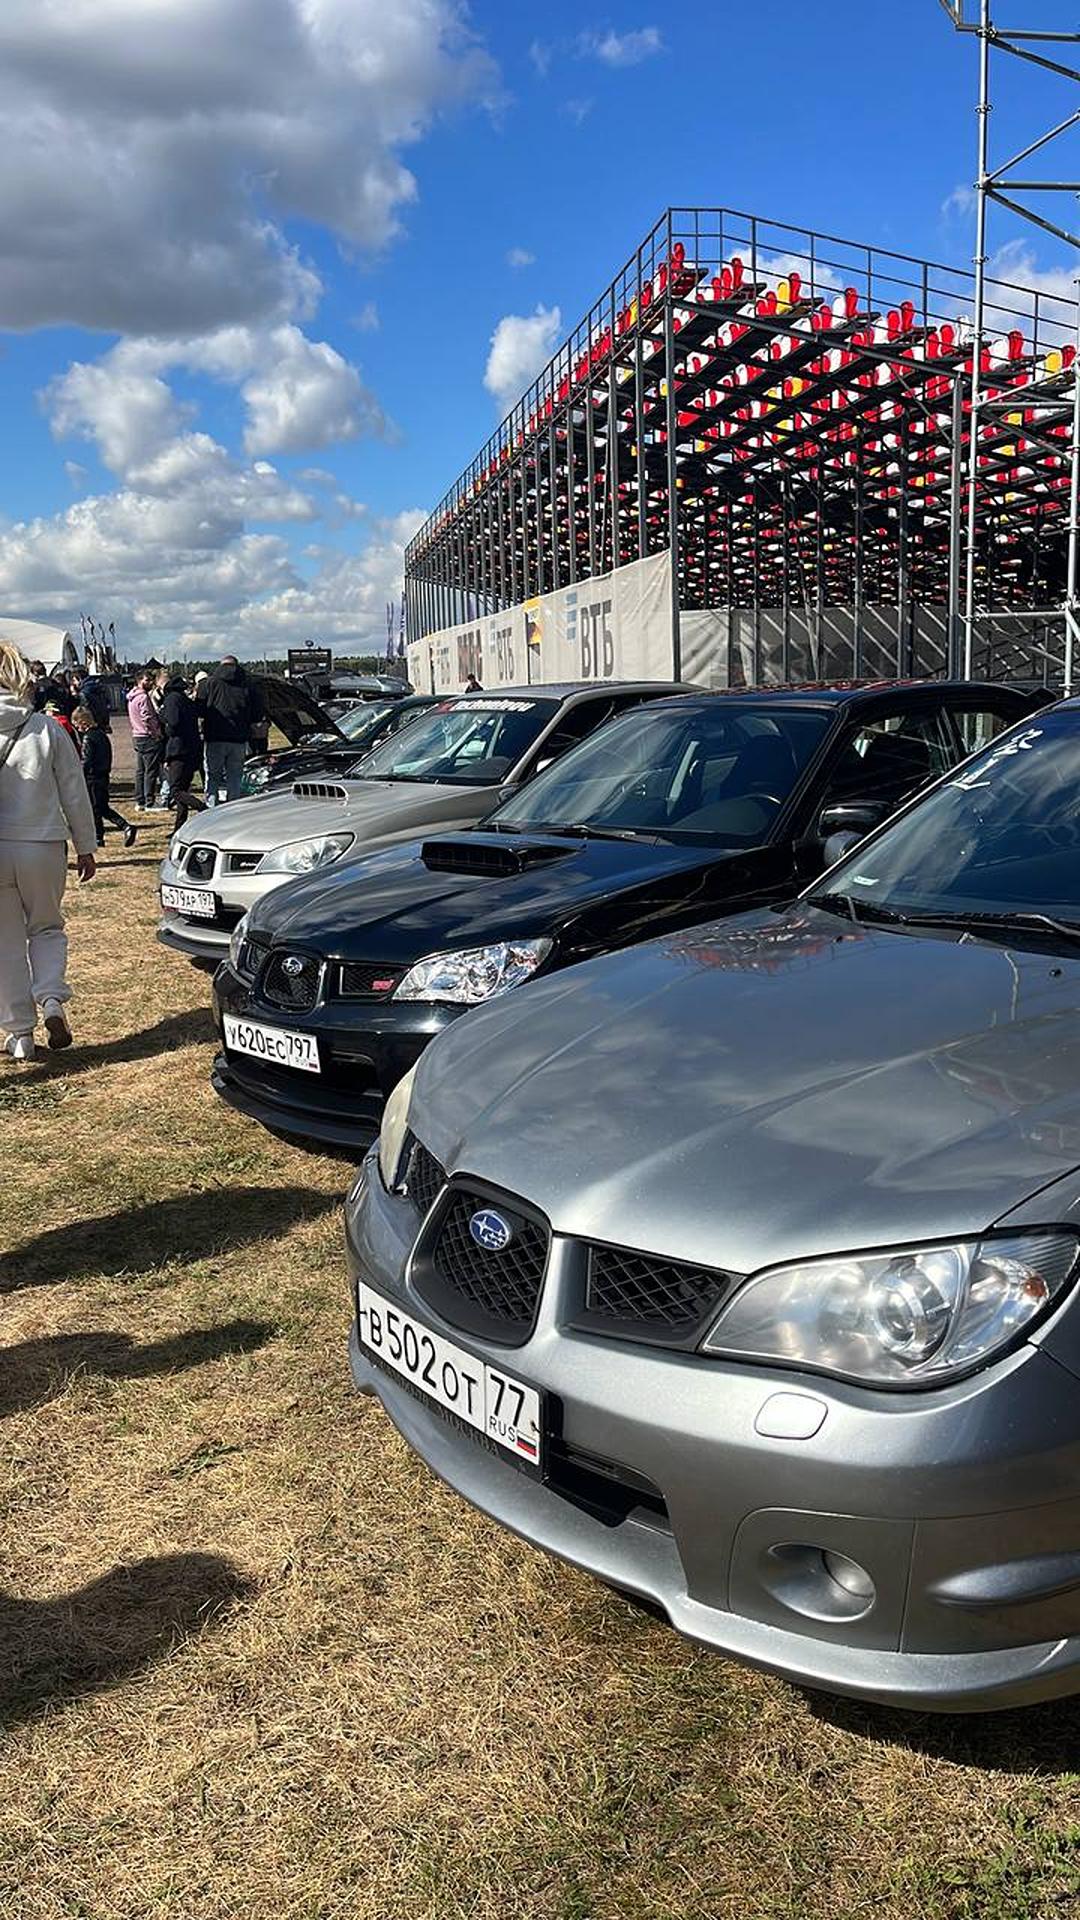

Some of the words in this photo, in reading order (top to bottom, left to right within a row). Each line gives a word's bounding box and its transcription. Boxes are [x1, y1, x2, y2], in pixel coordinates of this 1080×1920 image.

[580, 599, 615, 678] ВТБ
[230, 1024, 286, 1060] У620ЕС
[286, 1035, 311, 1059] 797
[369, 1307, 478, 1415] В502ОТ
[490, 1373, 525, 1426] 77
[489, 1415, 516, 1442] RUS
